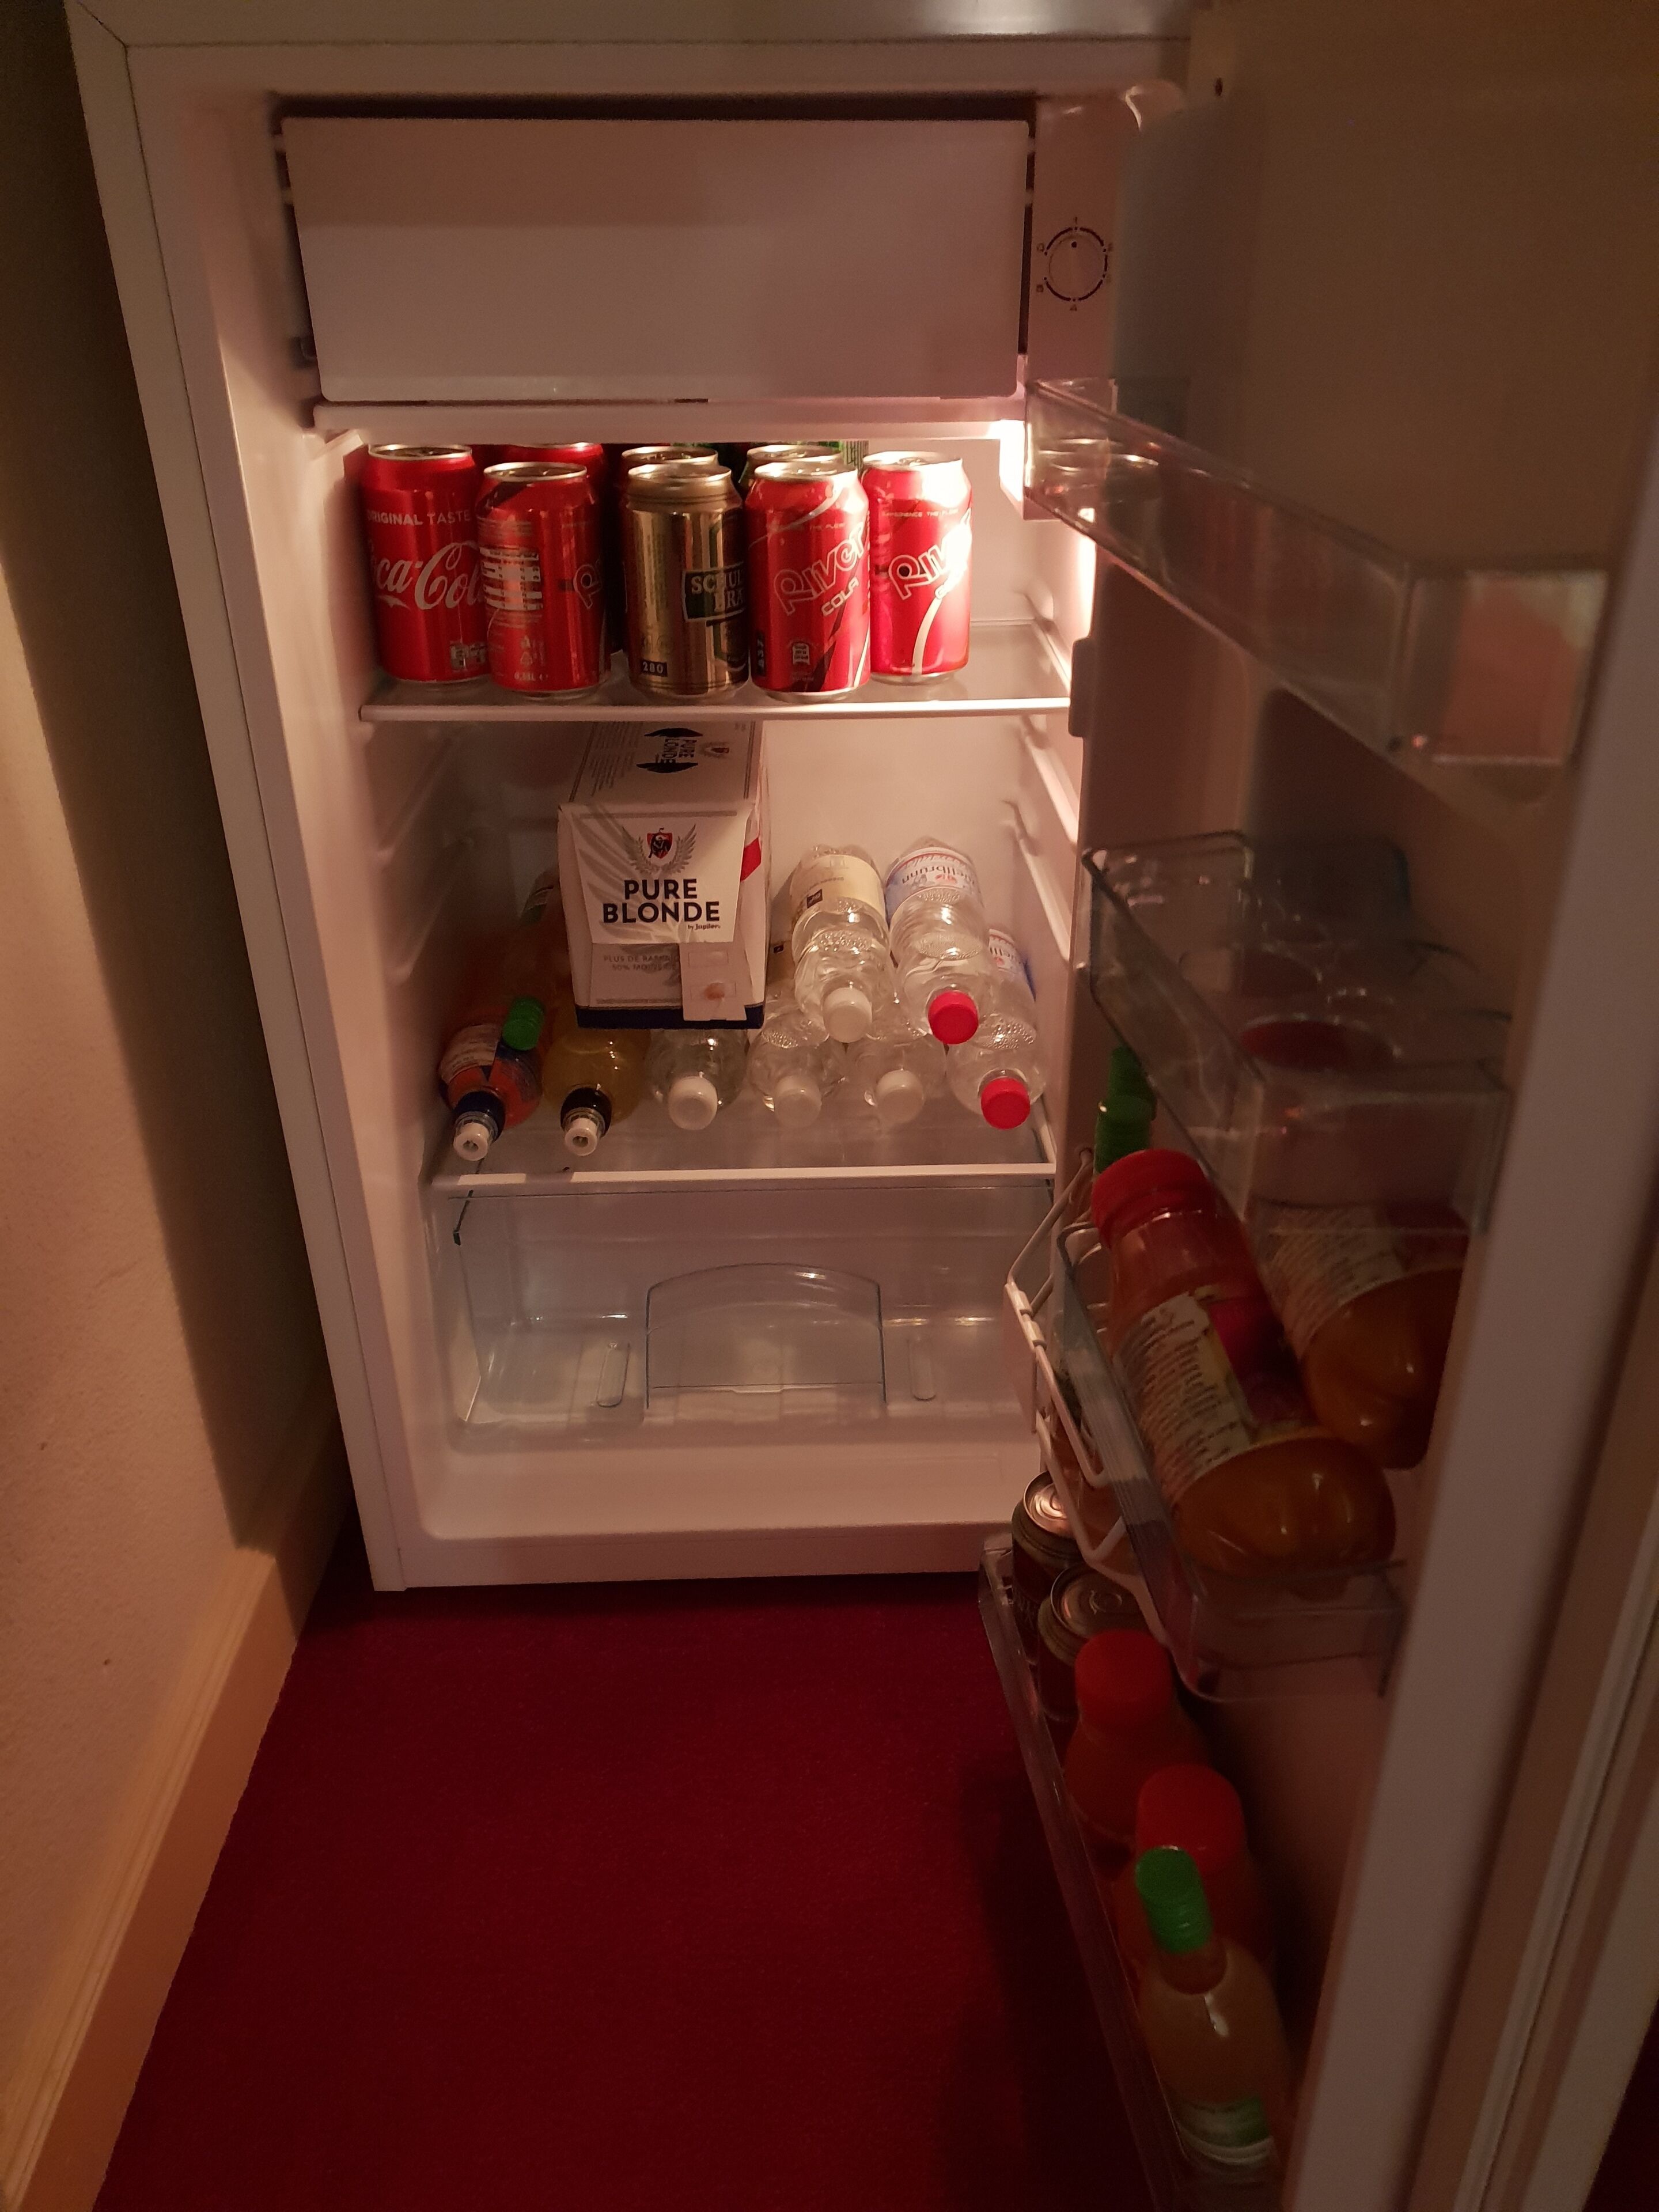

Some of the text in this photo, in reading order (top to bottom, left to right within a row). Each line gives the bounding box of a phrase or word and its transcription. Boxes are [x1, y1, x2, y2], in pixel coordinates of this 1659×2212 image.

[427, 509, 471, 525] TASTE
[370, 540, 483, 610] ca-Col
[821, 576, 859, 617] COLA
[642, 661, 664, 674] 280
[902, 865, 975, 886] uellbrunn
[624, 879, 698, 901] PURE
[603, 901, 720, 924] BLONDE
